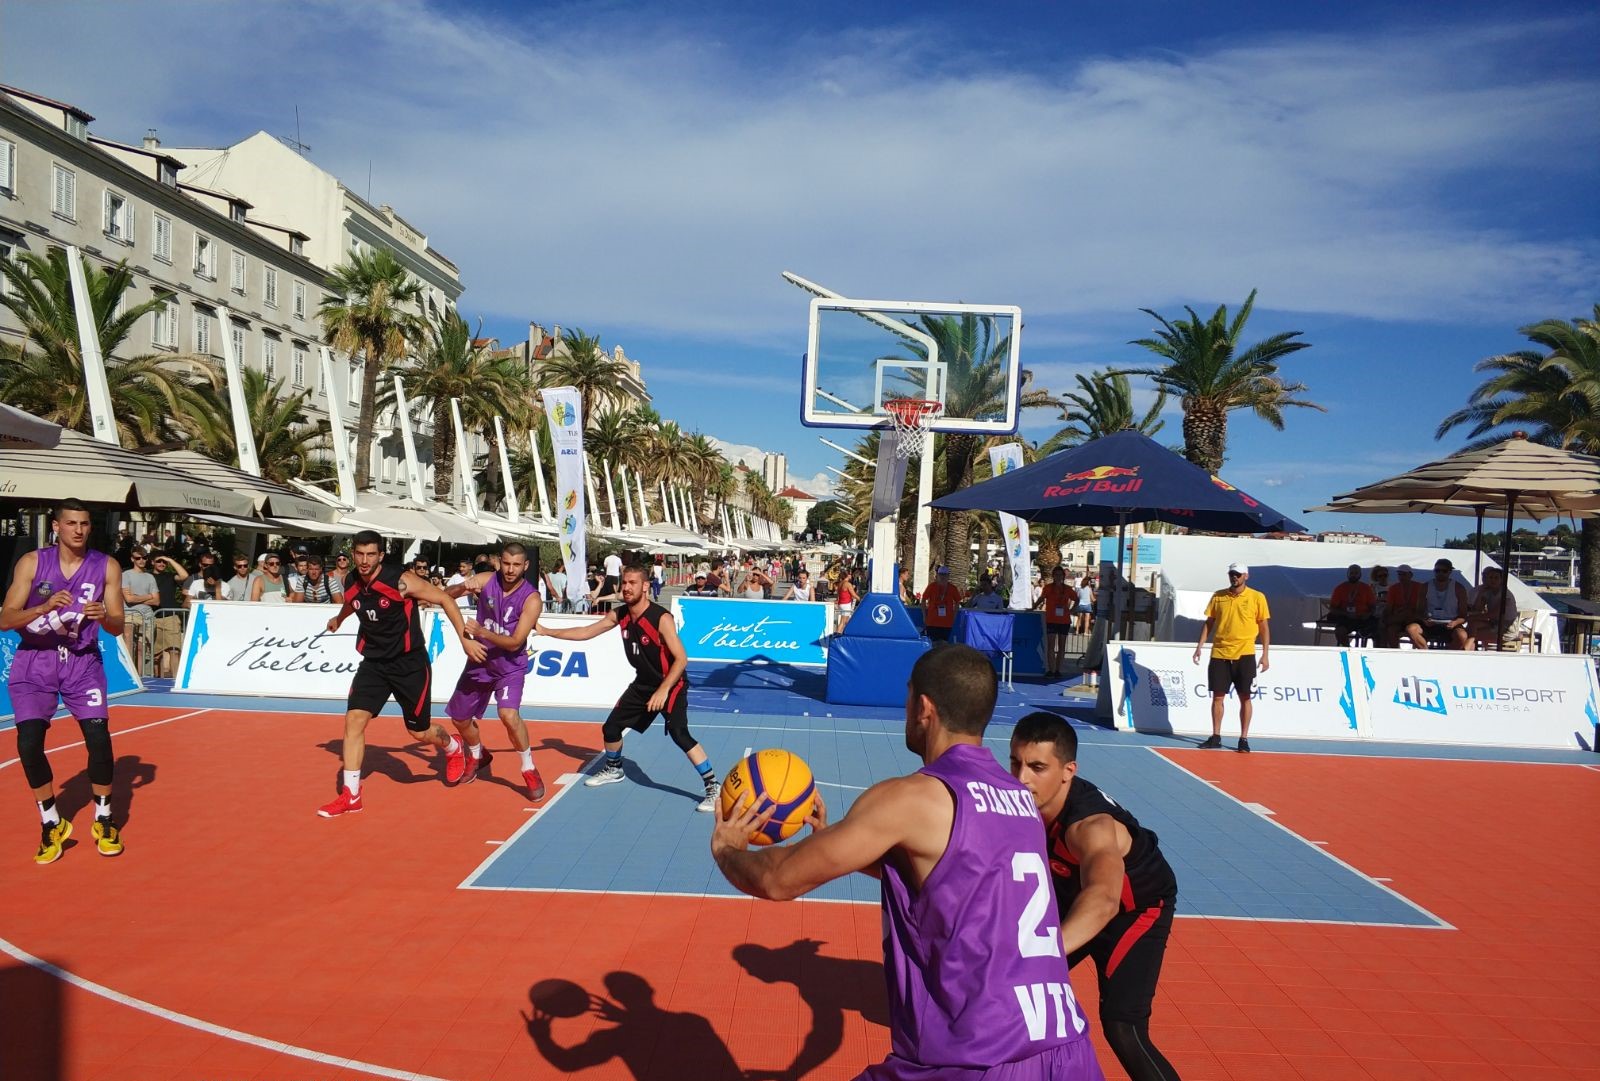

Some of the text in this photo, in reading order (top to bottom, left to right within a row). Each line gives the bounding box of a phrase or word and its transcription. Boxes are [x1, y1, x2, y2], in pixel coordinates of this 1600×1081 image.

[1043, 479, 1144, 497] Red Bull
[78, 582, 96, 604] 3
[366, 609, 379, 622] 12
[503, 606, 514, 623] 1
[698, 615, 793, 645] just
[227, 626, 358, 667] just
[714, 633, 801, 650] believe
[248, 650, 358, 673] believ
[86, 688, 103, 707] 3
[502, 685, 509, 700] 1
[1273, 686, 1323, 702] SPLIT
[1401, 675, 1440, 708] HR
[1455, 703, 1531, 712] HRVATSKA
[966, 781, 1039, 822] STANKO
[1011, 852, 1061, 958] 2
